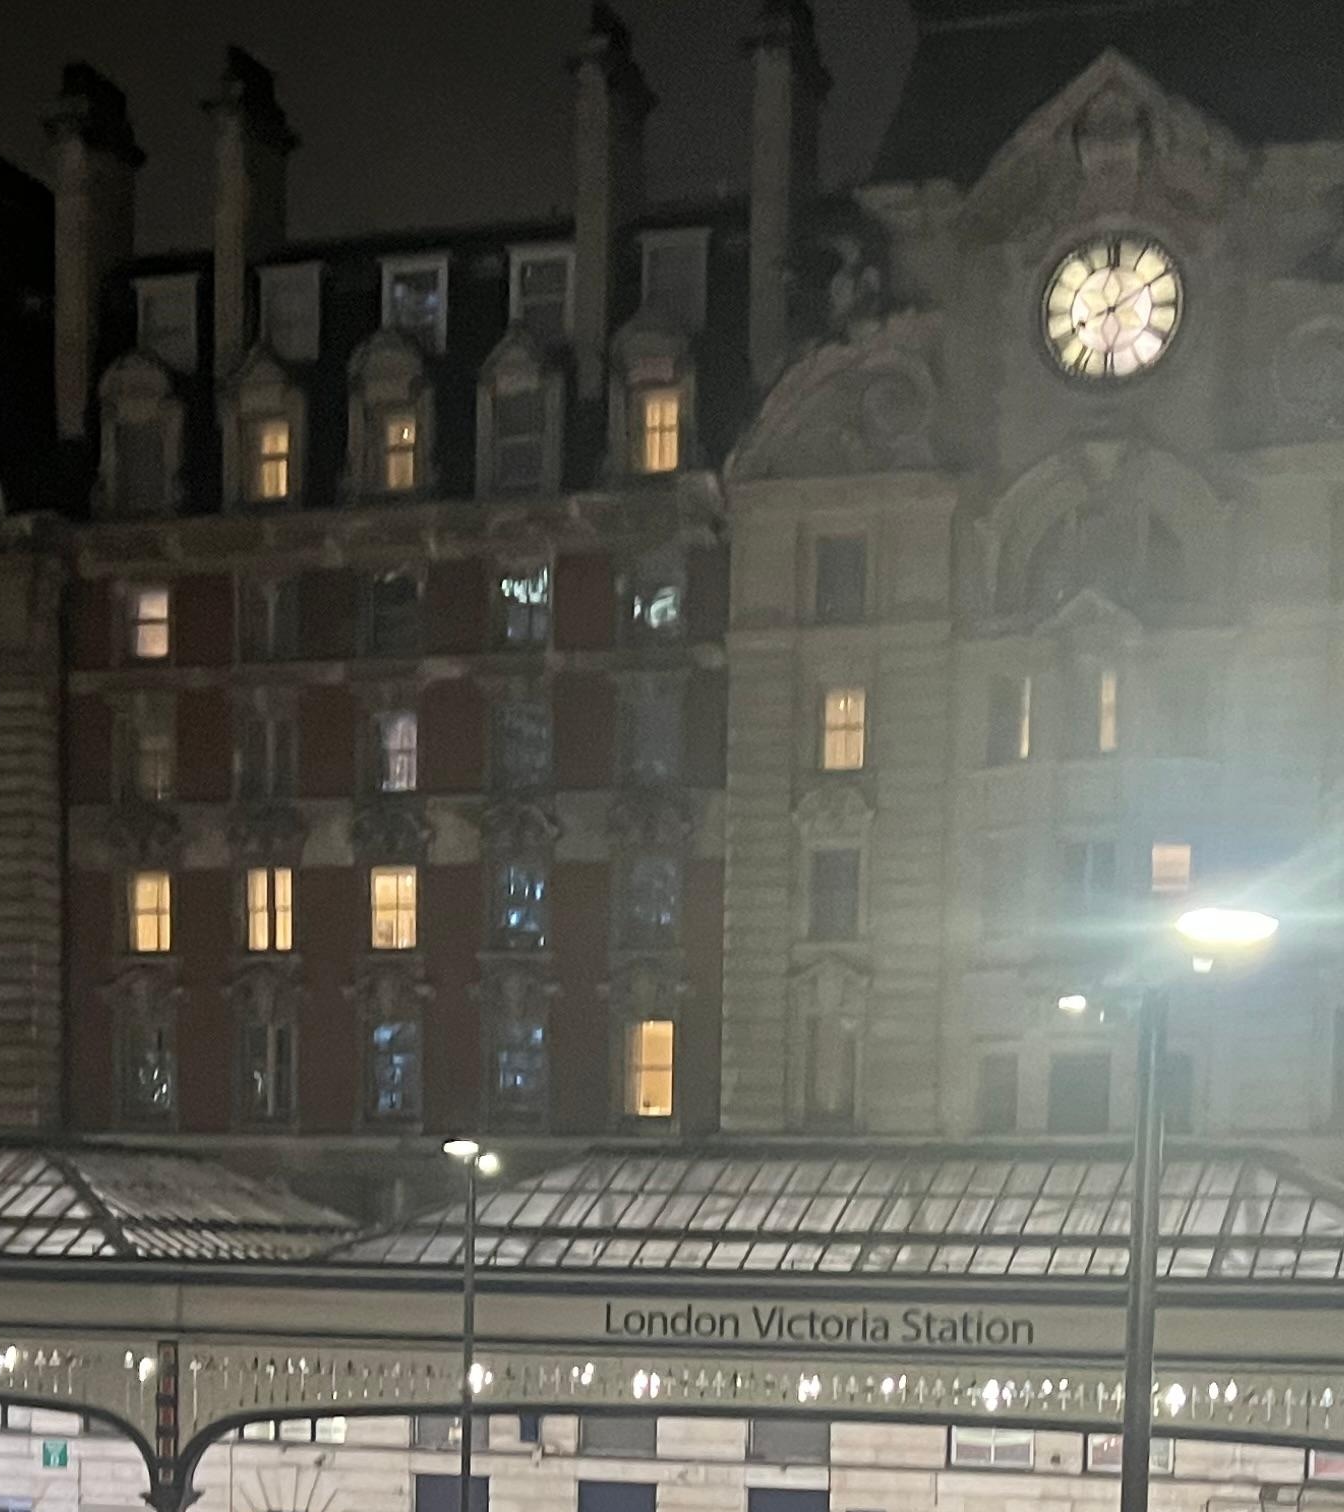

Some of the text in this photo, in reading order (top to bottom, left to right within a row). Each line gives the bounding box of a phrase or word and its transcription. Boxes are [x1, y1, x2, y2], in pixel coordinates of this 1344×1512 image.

[605, 1303, 1035, 1345] London Victoria Station
